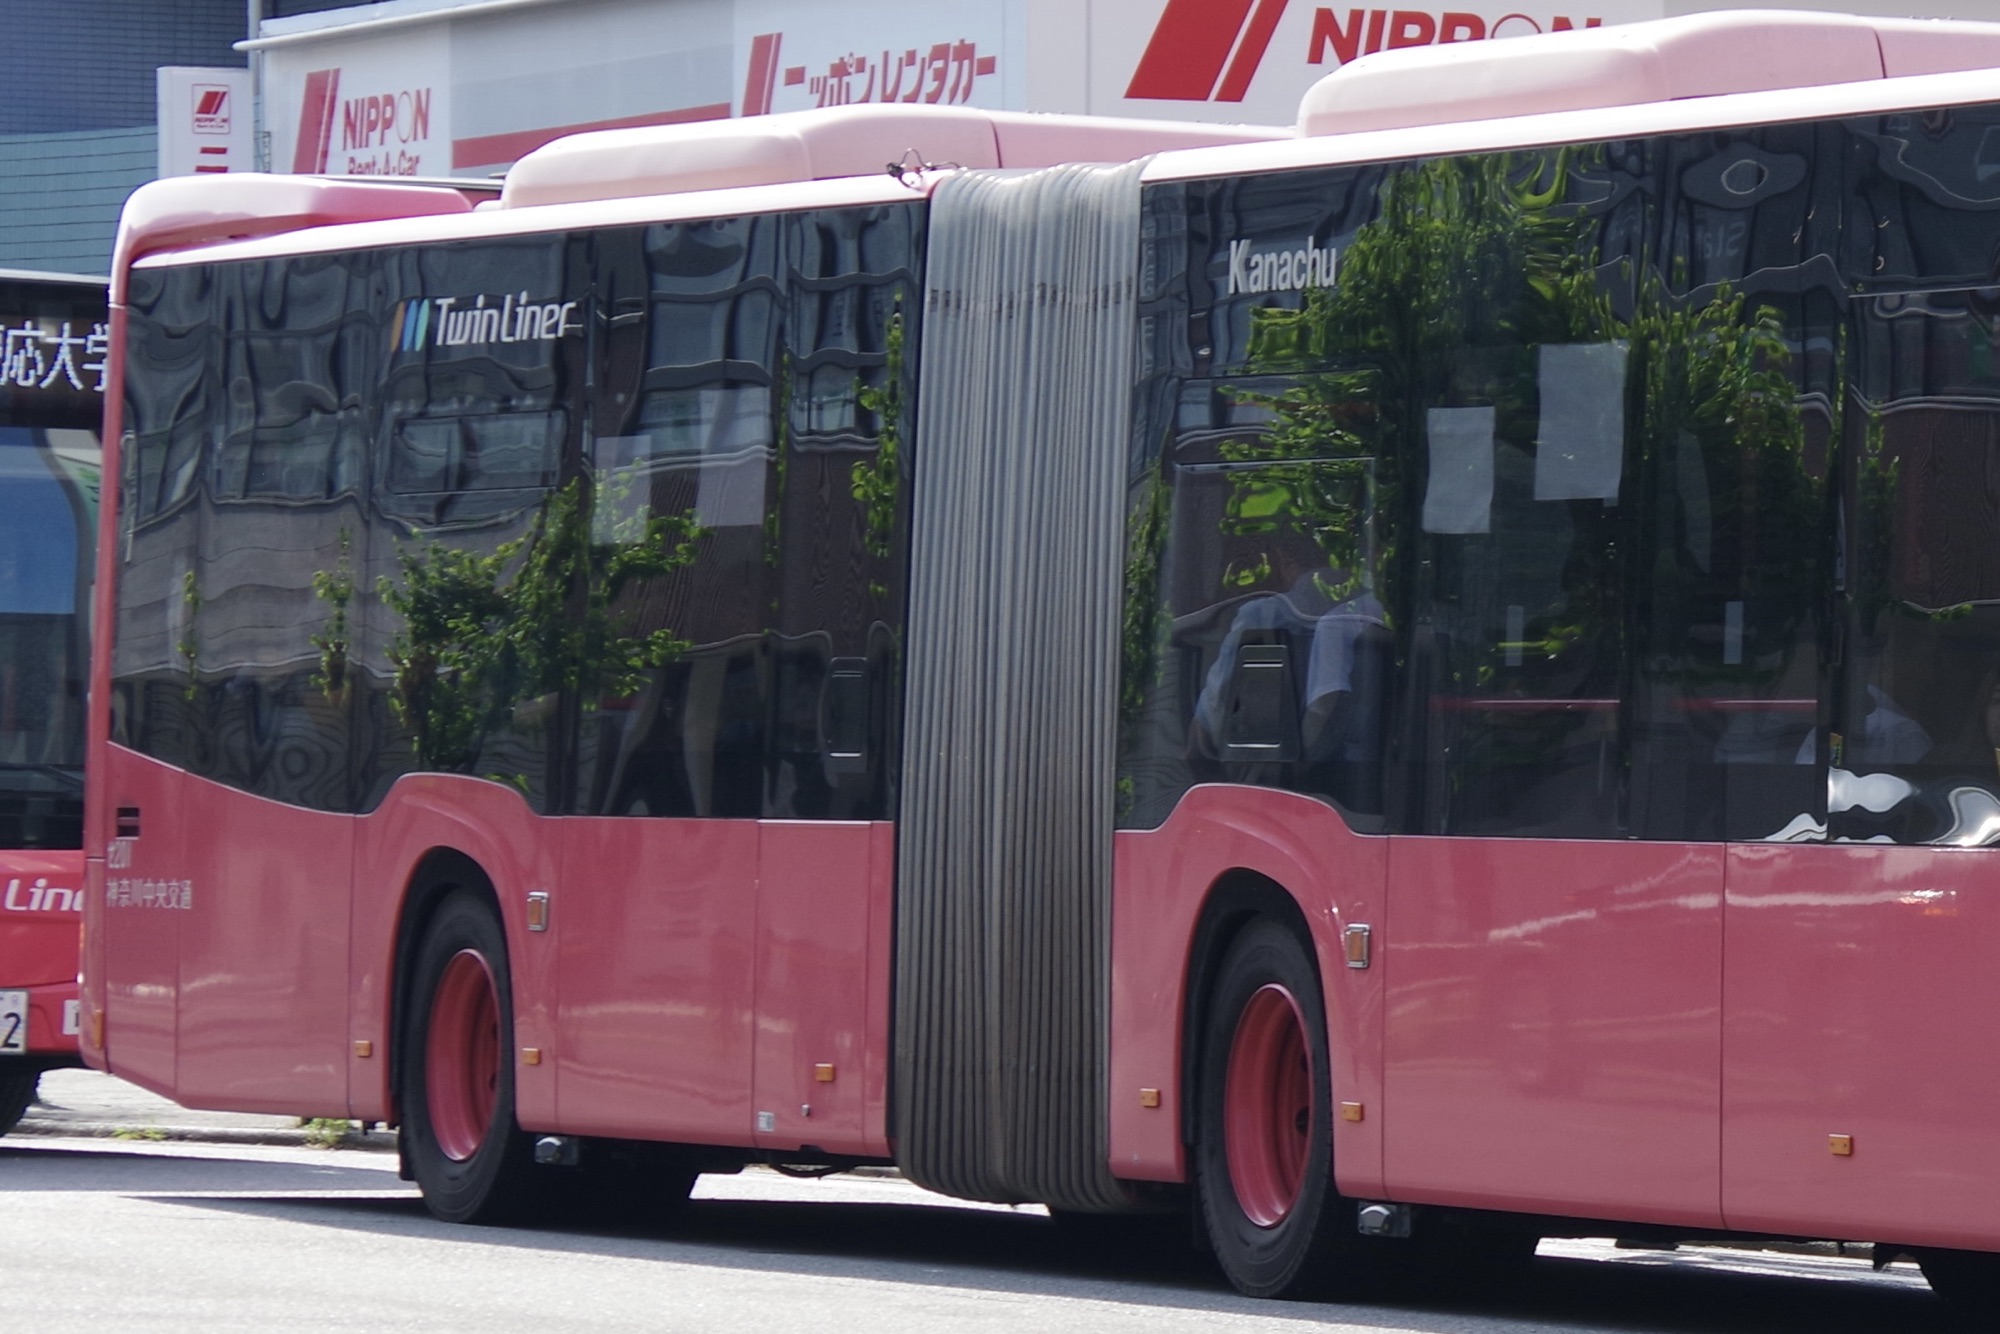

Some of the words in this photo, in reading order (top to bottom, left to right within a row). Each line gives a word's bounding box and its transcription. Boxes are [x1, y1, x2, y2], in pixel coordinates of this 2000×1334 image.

[1307, 7, 1602, 64] NIPP
[342, 87, 431, 151] NIPPON
[1228, 235, 1337, 294] Kanachu
[435, 290, 577, 346] TwinLiner
[0, 320, 108, 392] 応大学
[105, 878, 192, 910] 神奈川中央交通
